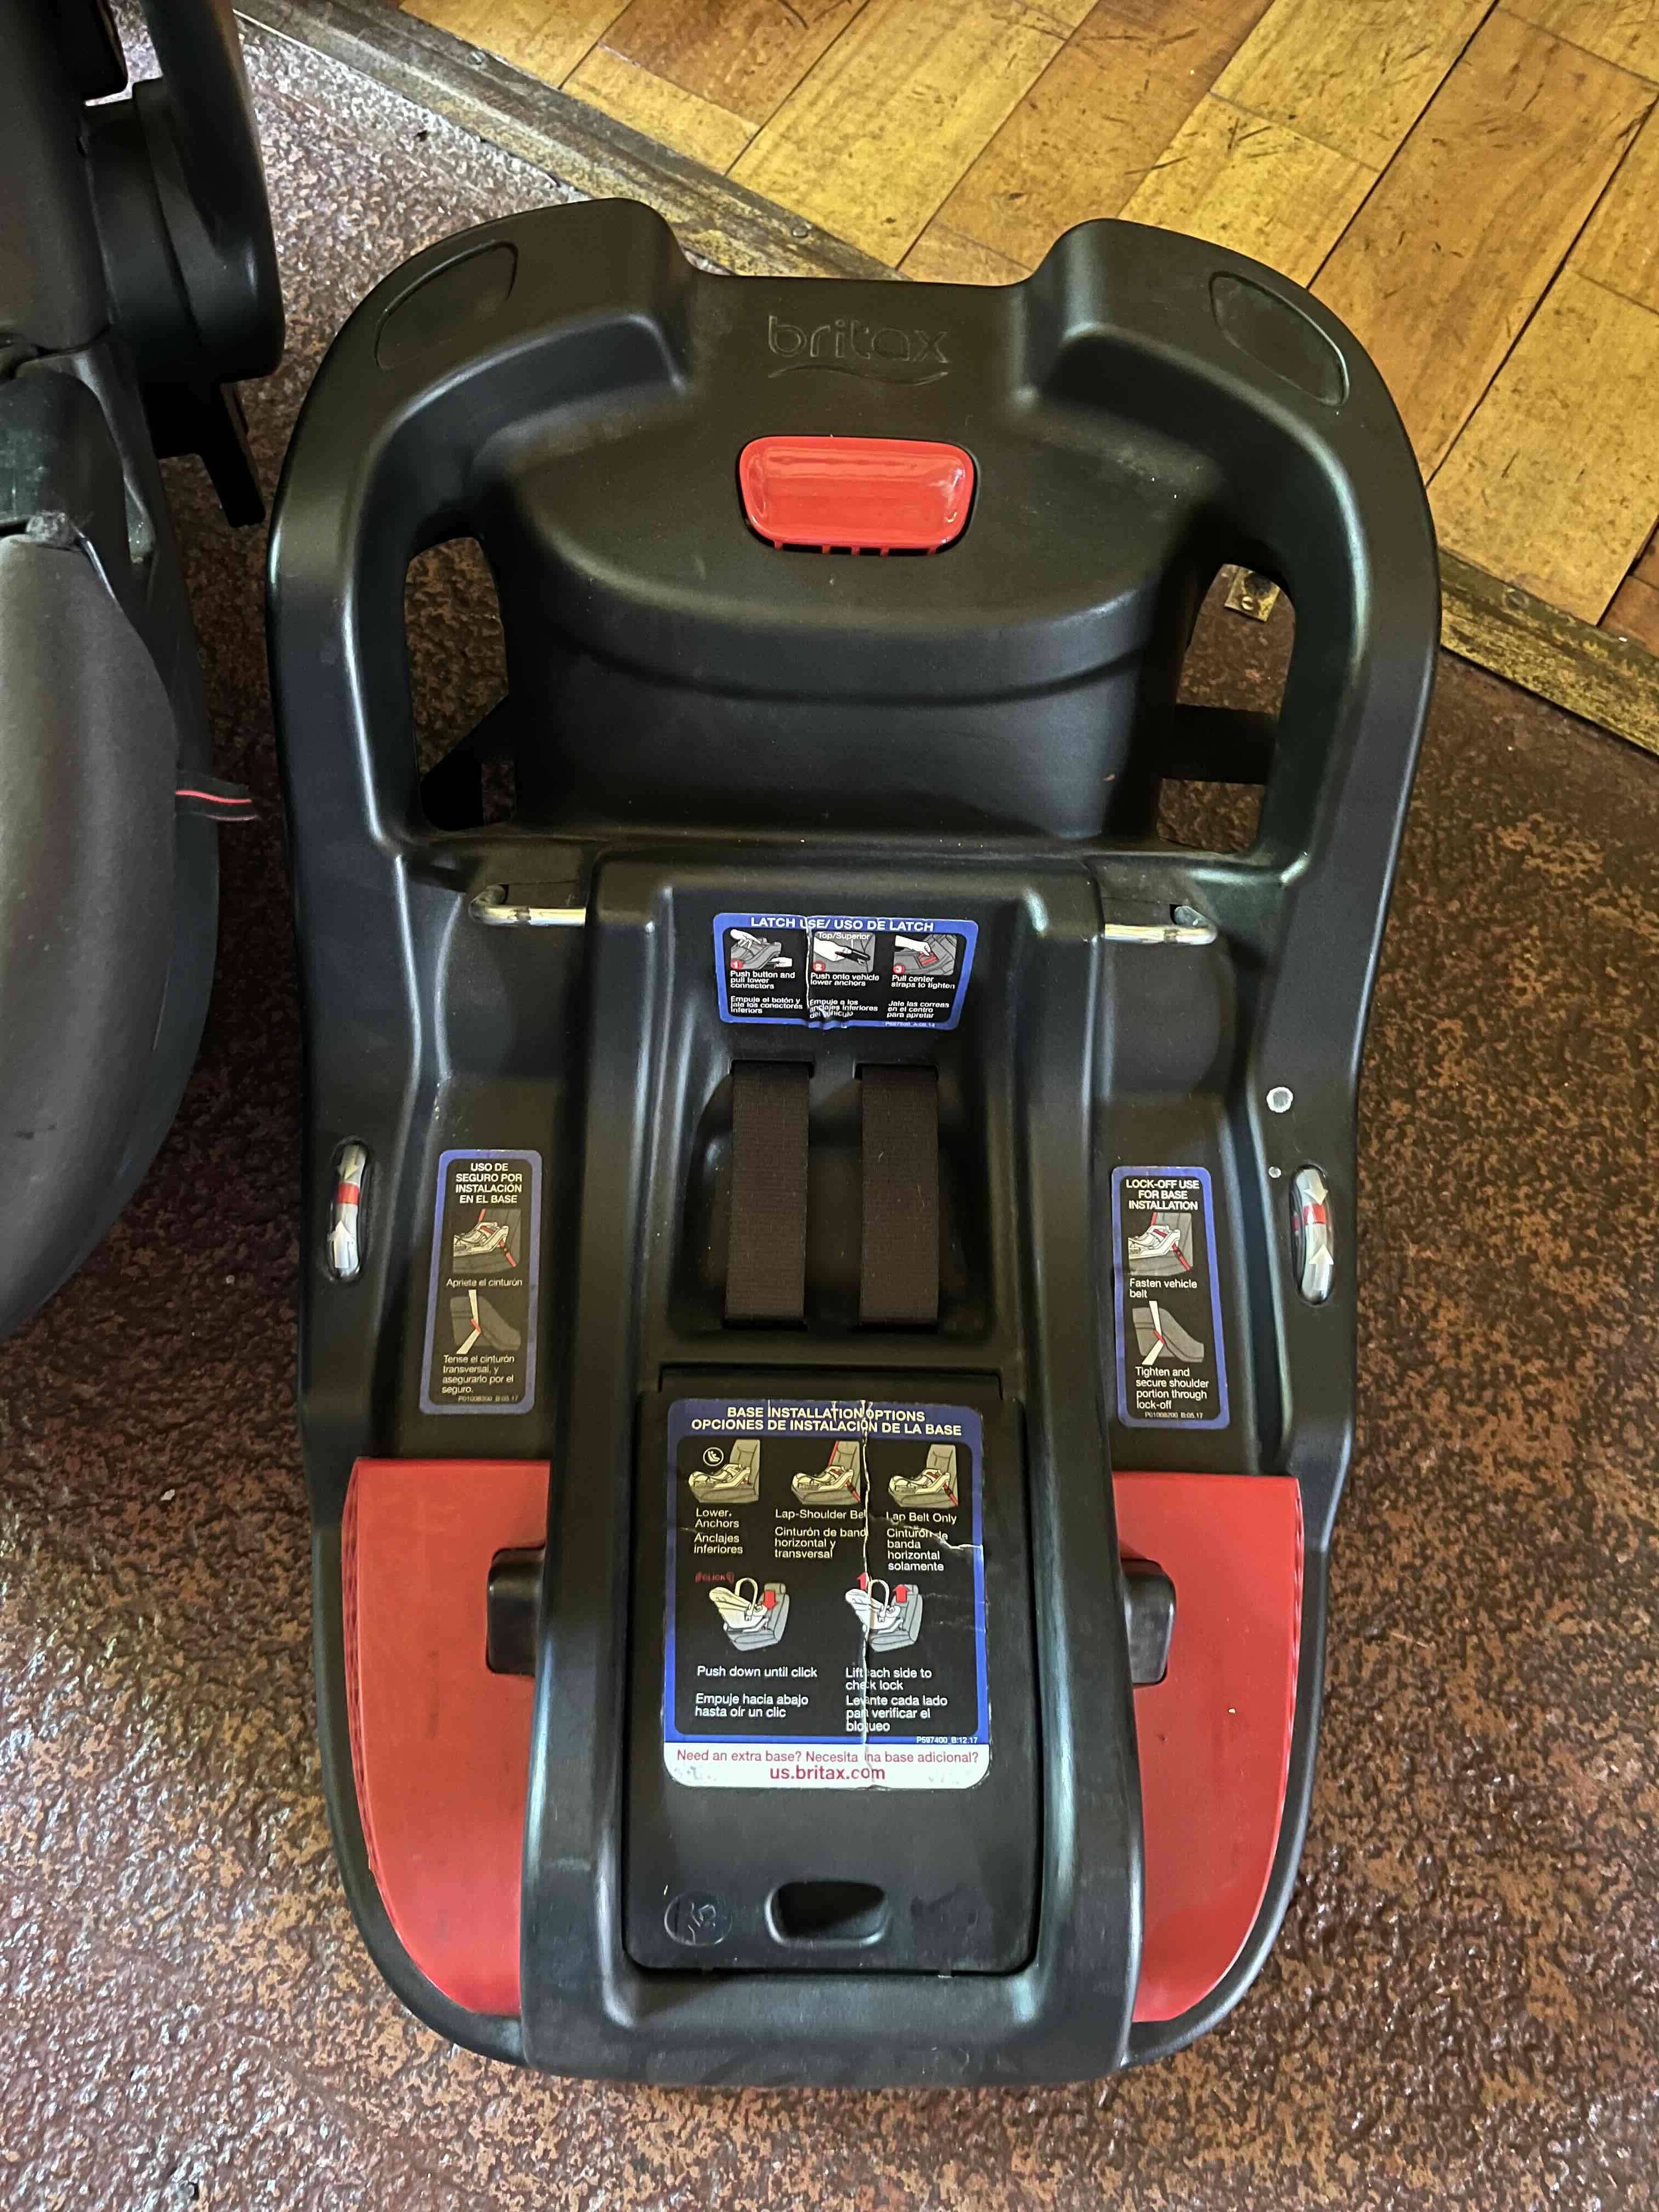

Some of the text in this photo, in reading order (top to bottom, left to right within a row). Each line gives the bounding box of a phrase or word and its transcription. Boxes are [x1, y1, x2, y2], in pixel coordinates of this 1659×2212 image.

[769, 315, 949, 363] britax
[751, 917, 933, 932] LATCH USE/ USO DE LATCH
[471, 1163, 508, 1172] USO DE
[456, 1173, 522, 1182] SEGURO POR
[455, 1182, 522, 1193] INSTALACIÓN
[1126, 1179, 1200, 1189] LOCK-OFF USE
[460, 1195, 518, 1203] EN EL BASE
[1138, 1190, 1188, 1199] FOR BASE
[1128, 1200, 1198, 1210] INSTALLATION
[446, 1279, 477, 1288] Apriete
[1130, 1278, 1197, 1289] Fasten vehicle
[1130, 1290, 1147, 1298] belt
[443, 1355, 515, 1363] Tense el cinturón
[494, 1366, 499, 1374] y
[1135, 1367, 1190, 1378] Tighten and
[442, 1375, 514, 1385] asegurarlo por el
[1136, 1378, 1209, 1388] secure shoulder
[442, 1386, 473, 1396] seguro.
[1137, 1389, 1207, 1401] portion through
[1137, 1400, 1172, 1409] lock-off
[727, 1407, 925, 1422] BASE INSTALLATION OPTIONS
[691, 1419, 764, 1430] OPCIONES
[768, 1420, 786, 1431] DE
[882, 1422, 900, 1434] DE
[904, 1423, 922, 1435] LA
[926, 1424, 962, 1436] BASE
[775, 1509, 867, 1520] Lap-Shoulder Bel
[909, 1512, 929, 1522] Belt
[933, 1513, 957, 1525] Only
[695, 1518, 740, 1528] Anchors
[775, 1526, 868, 1537] Cinturón de band
[694, 1532, 740, 1545] Anclajes
[775, 1537, 836, 1550] horizontal y
[694, 1544, 743, 1554] inferiores
[887, 1539, 921, 1549] banda
[775, 1549, 832, 1559] transversal
[888, 1550, 940, 1560] horizontal
[888, 1561, 944, 1571] solamente
[697, 1665, 817, 1678] Push down until click
[845, 1667, 863, 1678] Lift
[894, 1667, 917, 1678] side
[920, 1668, 932, 1678] to
[880, 1680, 904, 1690] lock
[696, 1692, 809, 1707] Empuje hacia abajo
[891, 1695, 919, 1706] cada
[923, 1695, 948, 1706] lado
[695, 1705, 786, 1718] hasta oír un clic
[872, 1707, 917, 1718] verificar
[919, 1708, 930, 1719] el
[677, 1749, 709, 1760] Need
[713, 1752, 727, 1761] an
[731, 1751, 762, 1762] extra
[765, 1750, 802, 1762] base?
[806, 1751, 858, 1763] Necesita
[885, 1751, 913, 1763] base
[917, 1751, 979, 1763] adicional?
[770, 1764, 885, 1780] us.britax.com
